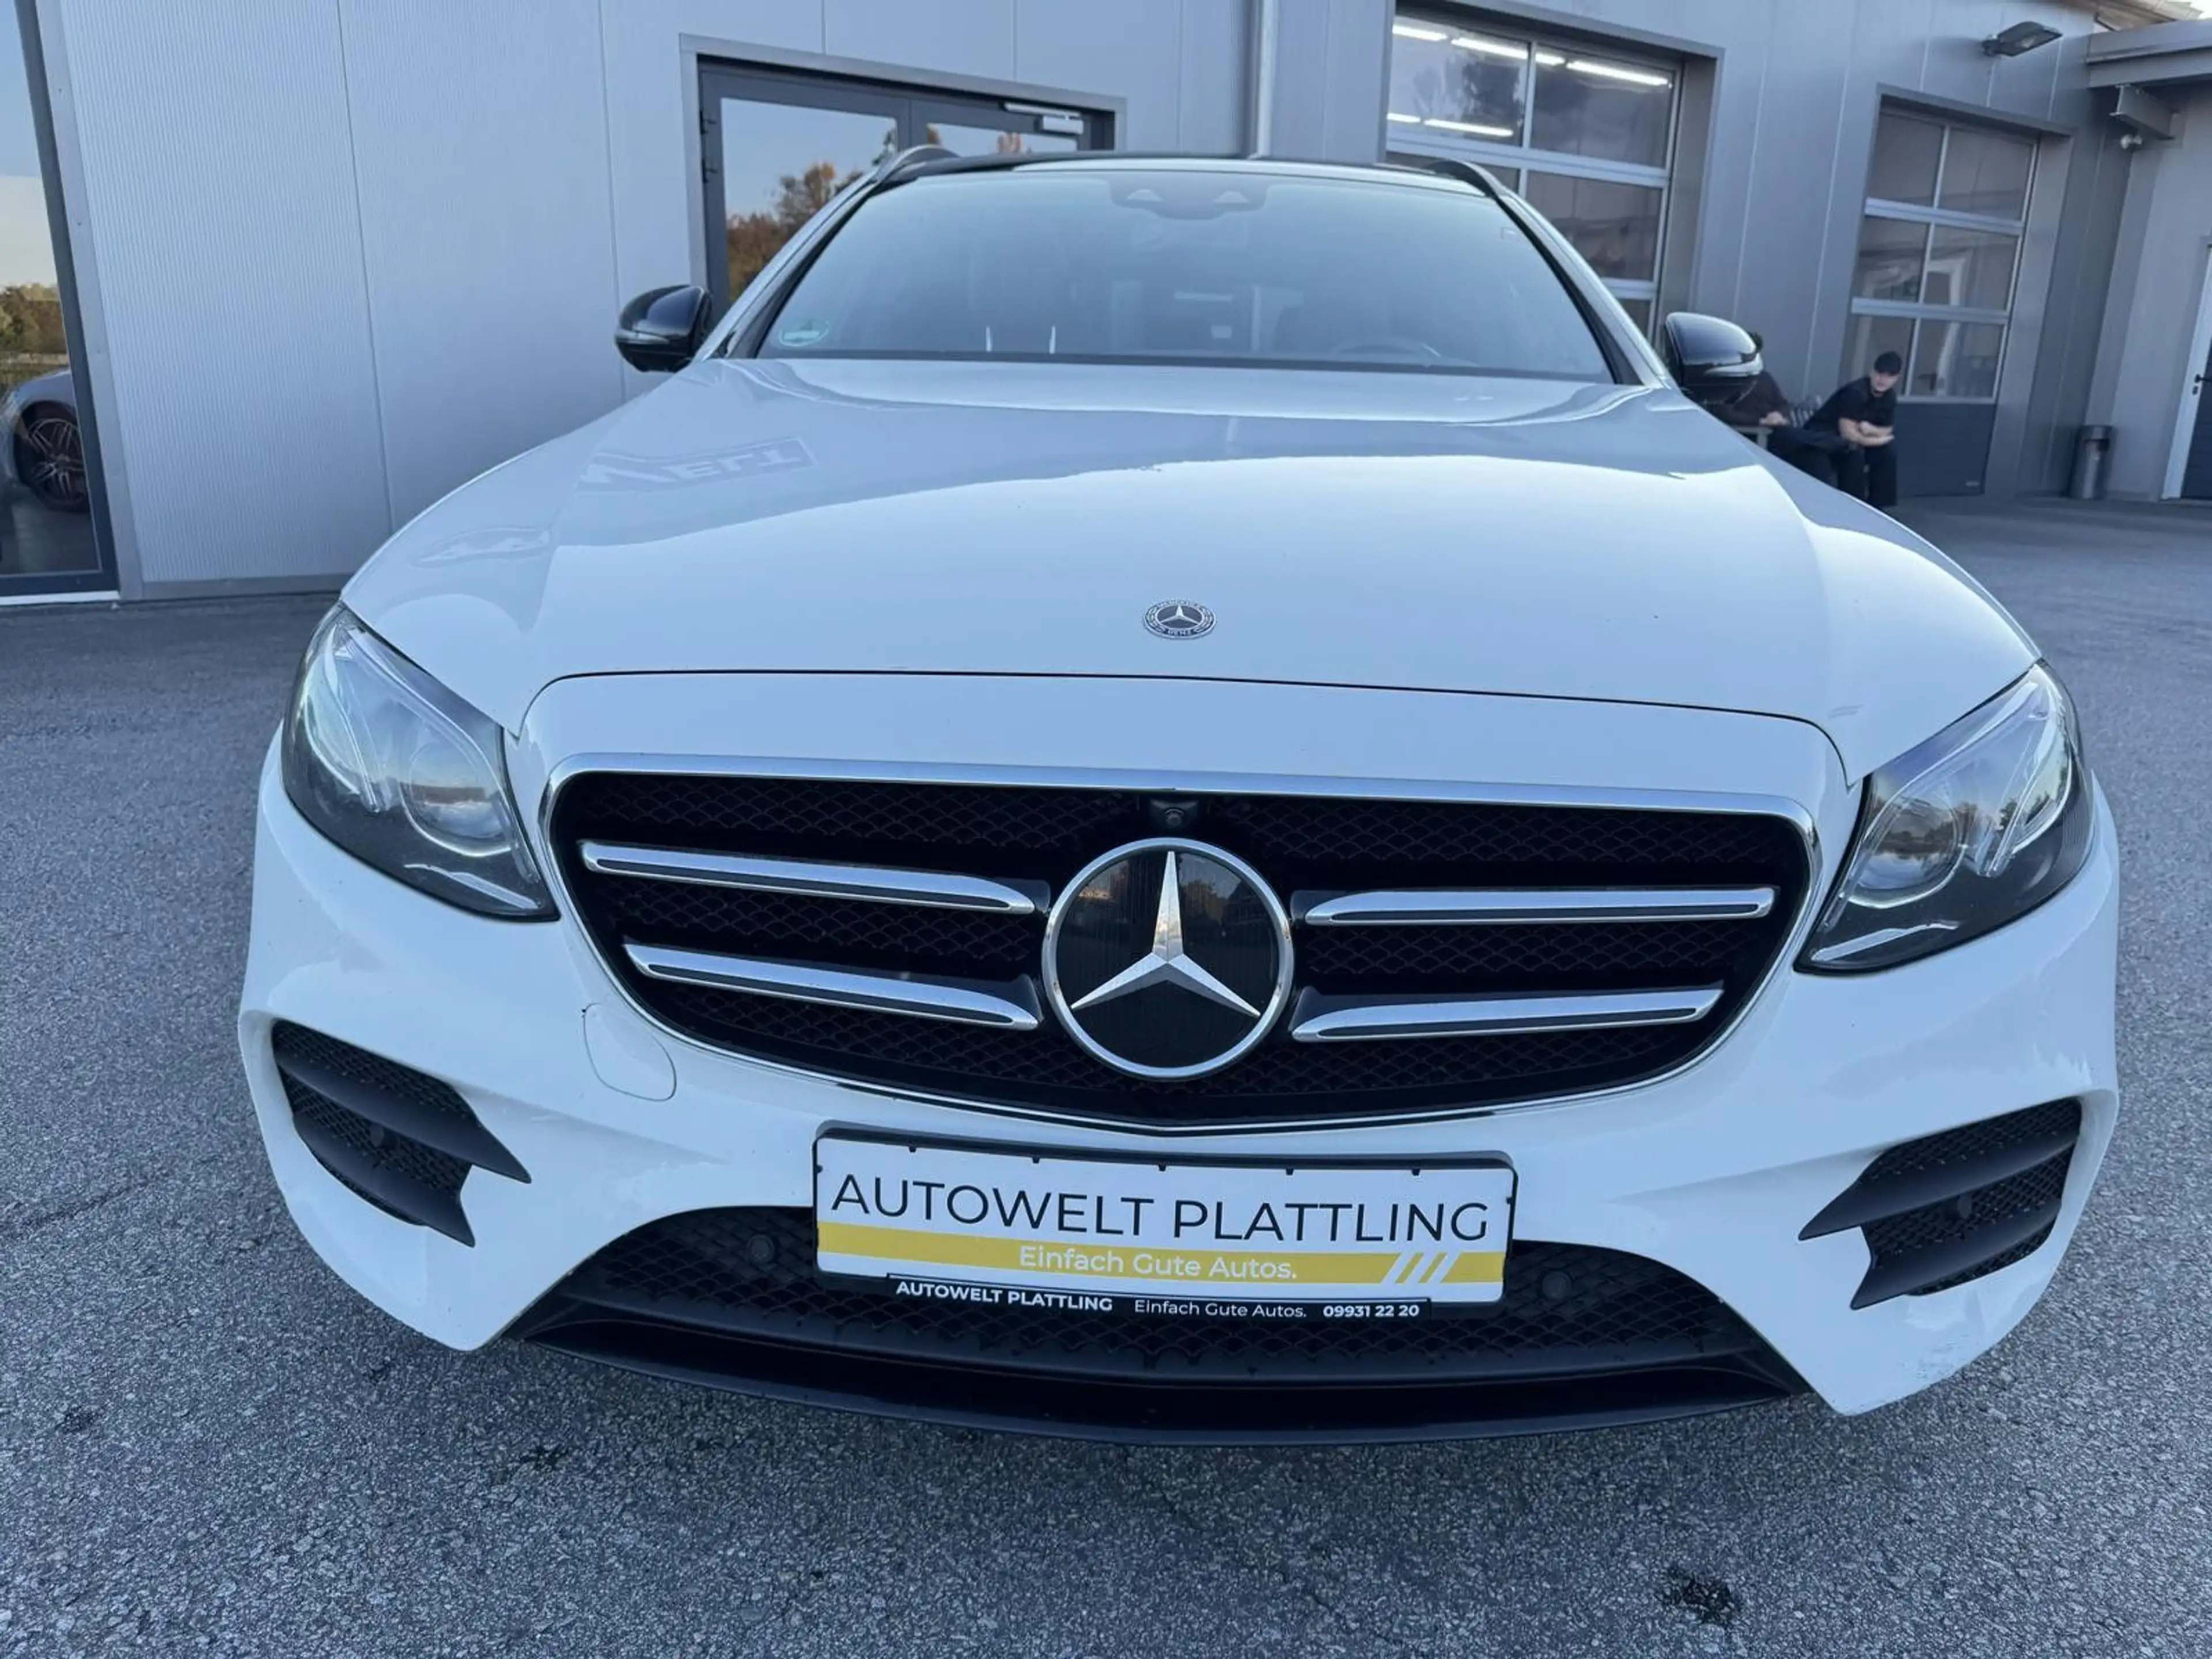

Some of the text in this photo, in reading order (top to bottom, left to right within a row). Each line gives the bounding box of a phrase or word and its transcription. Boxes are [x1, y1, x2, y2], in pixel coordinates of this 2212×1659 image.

[831, 1173, 1488, 1241] AUTOWELT PLATTLING
[1019, 1245, 1298, 1279] Einfach Gute Autos.
[896, 1281, 1420, 1318] AUTOWELT PLATTLING Einfach Gute Autos. 09931 22 20
